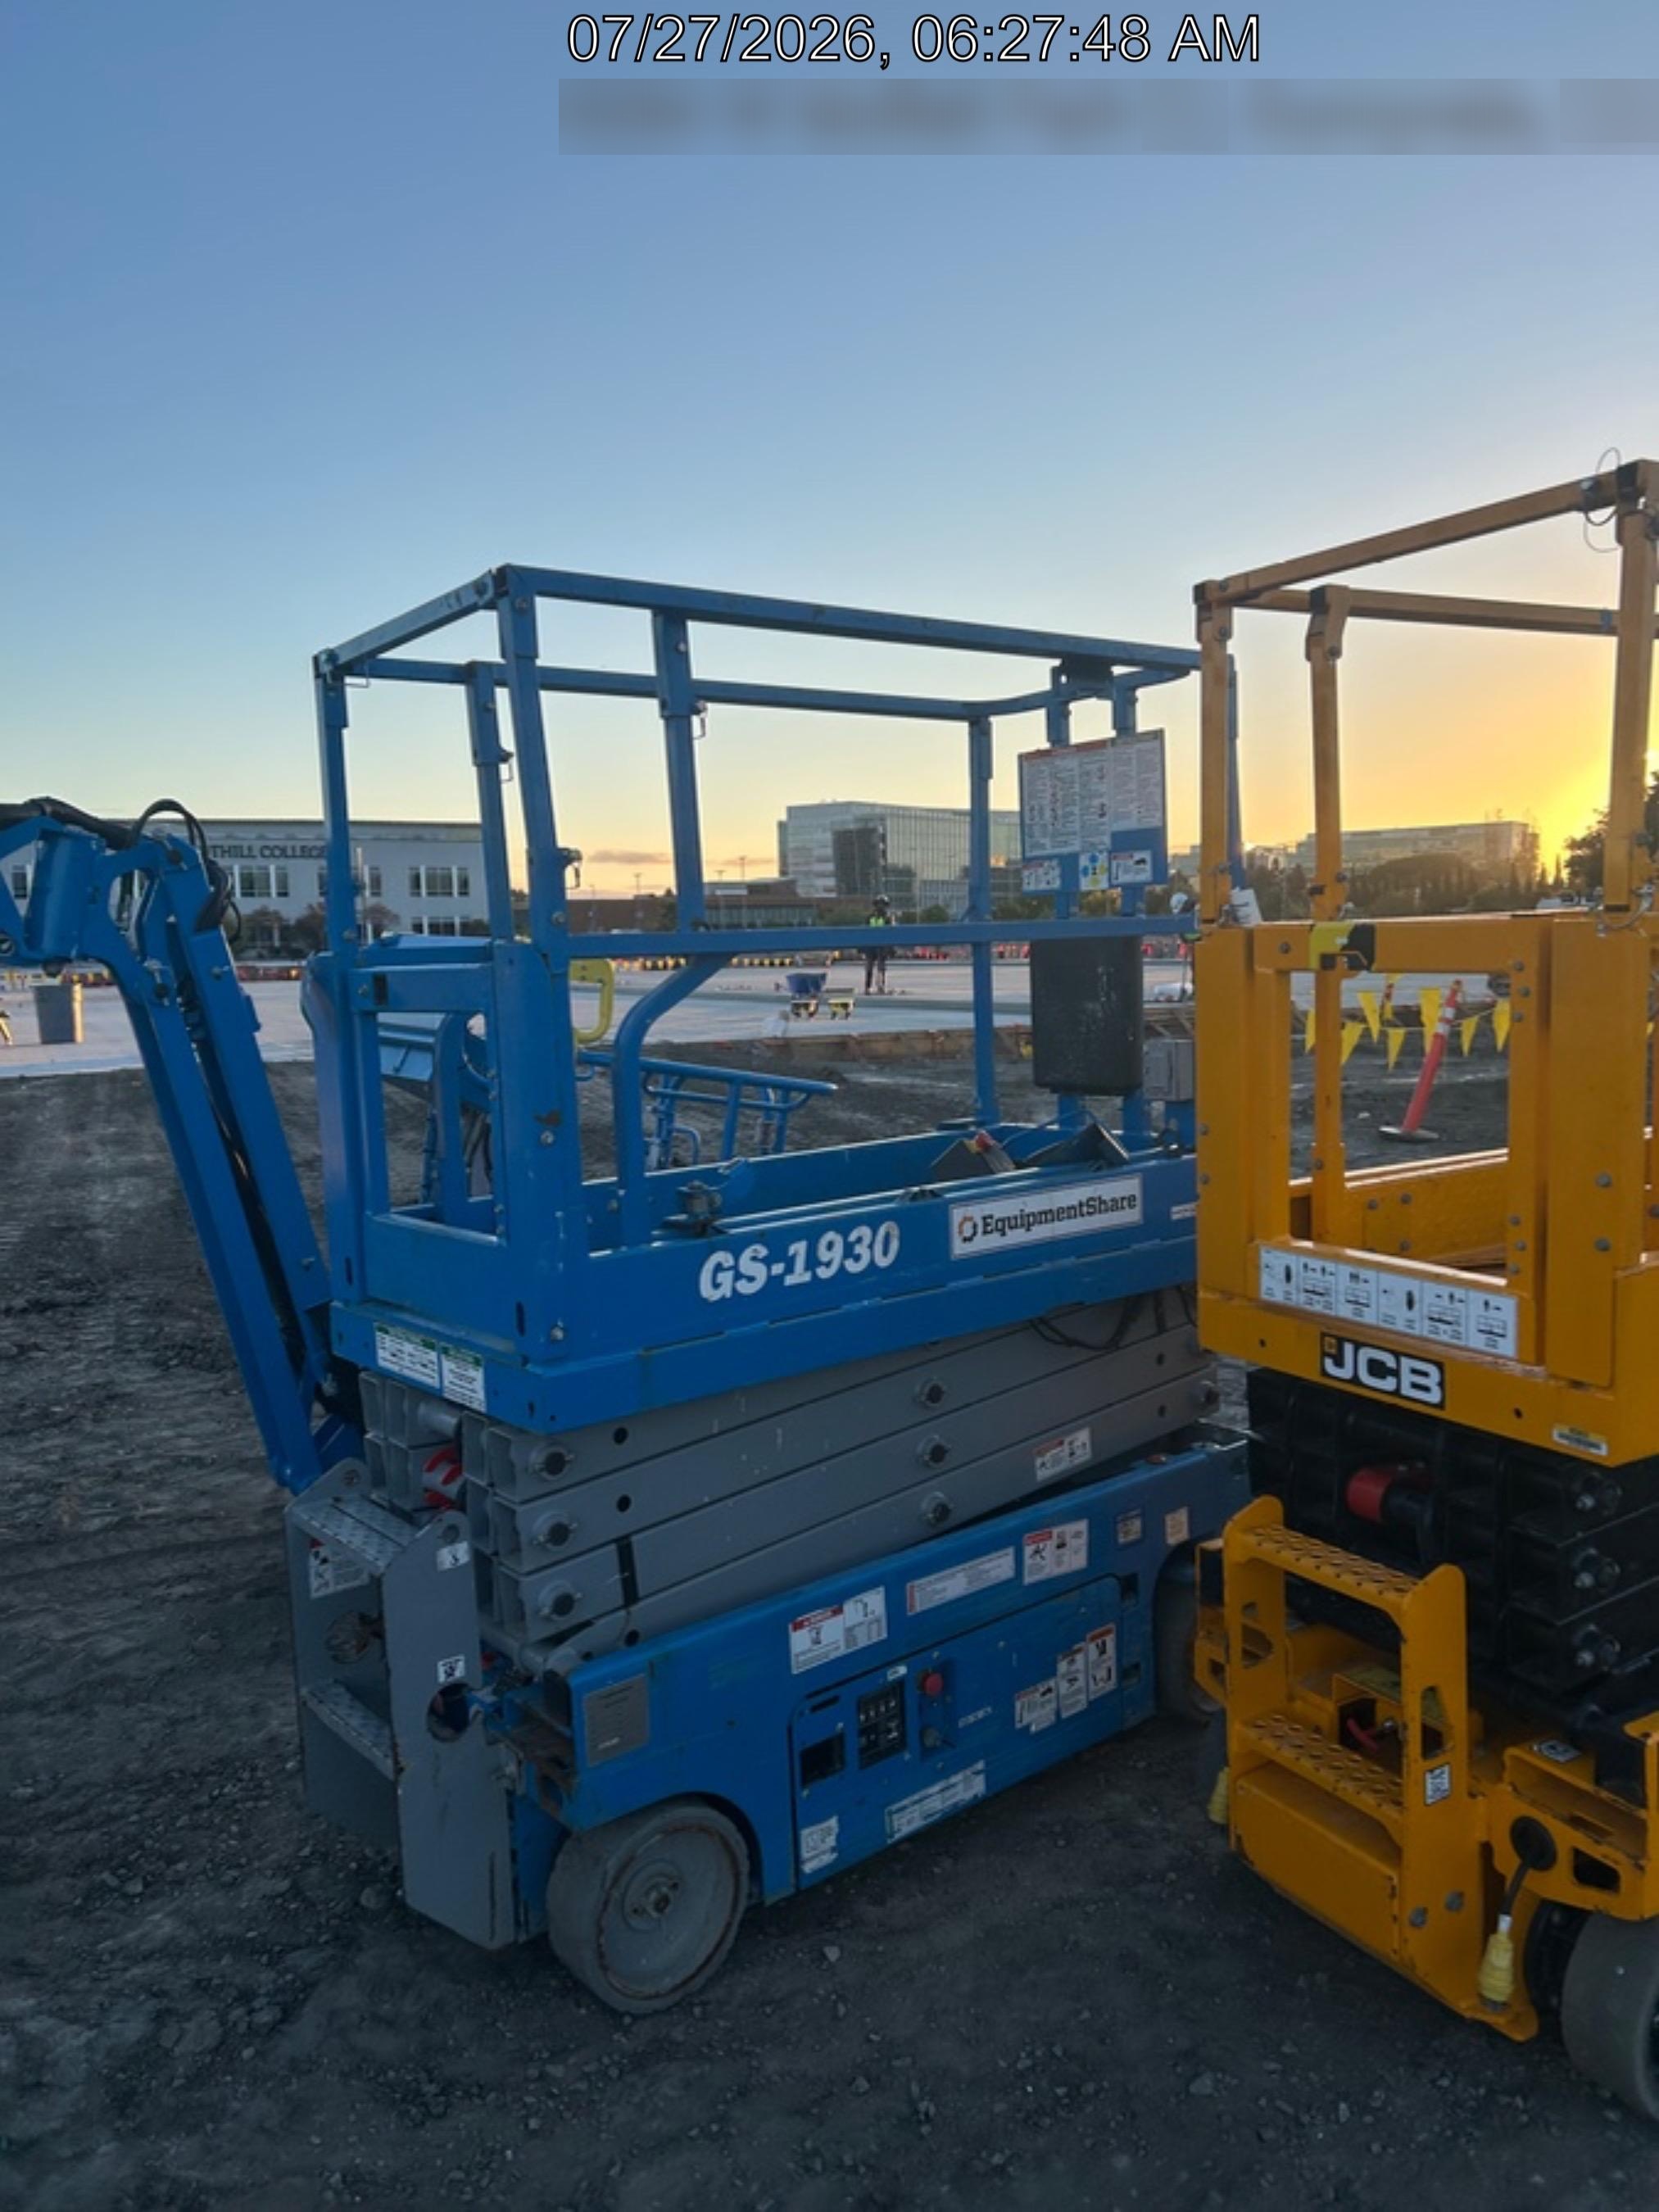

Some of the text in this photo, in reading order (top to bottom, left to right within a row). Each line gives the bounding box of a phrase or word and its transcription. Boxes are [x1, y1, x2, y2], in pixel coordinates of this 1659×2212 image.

[981, 1194, 1137, 1236] EquipmentShare
[699, 1221, 900, 1303] GS-1930
[1324, 1341, 1443, 1405] JCB
